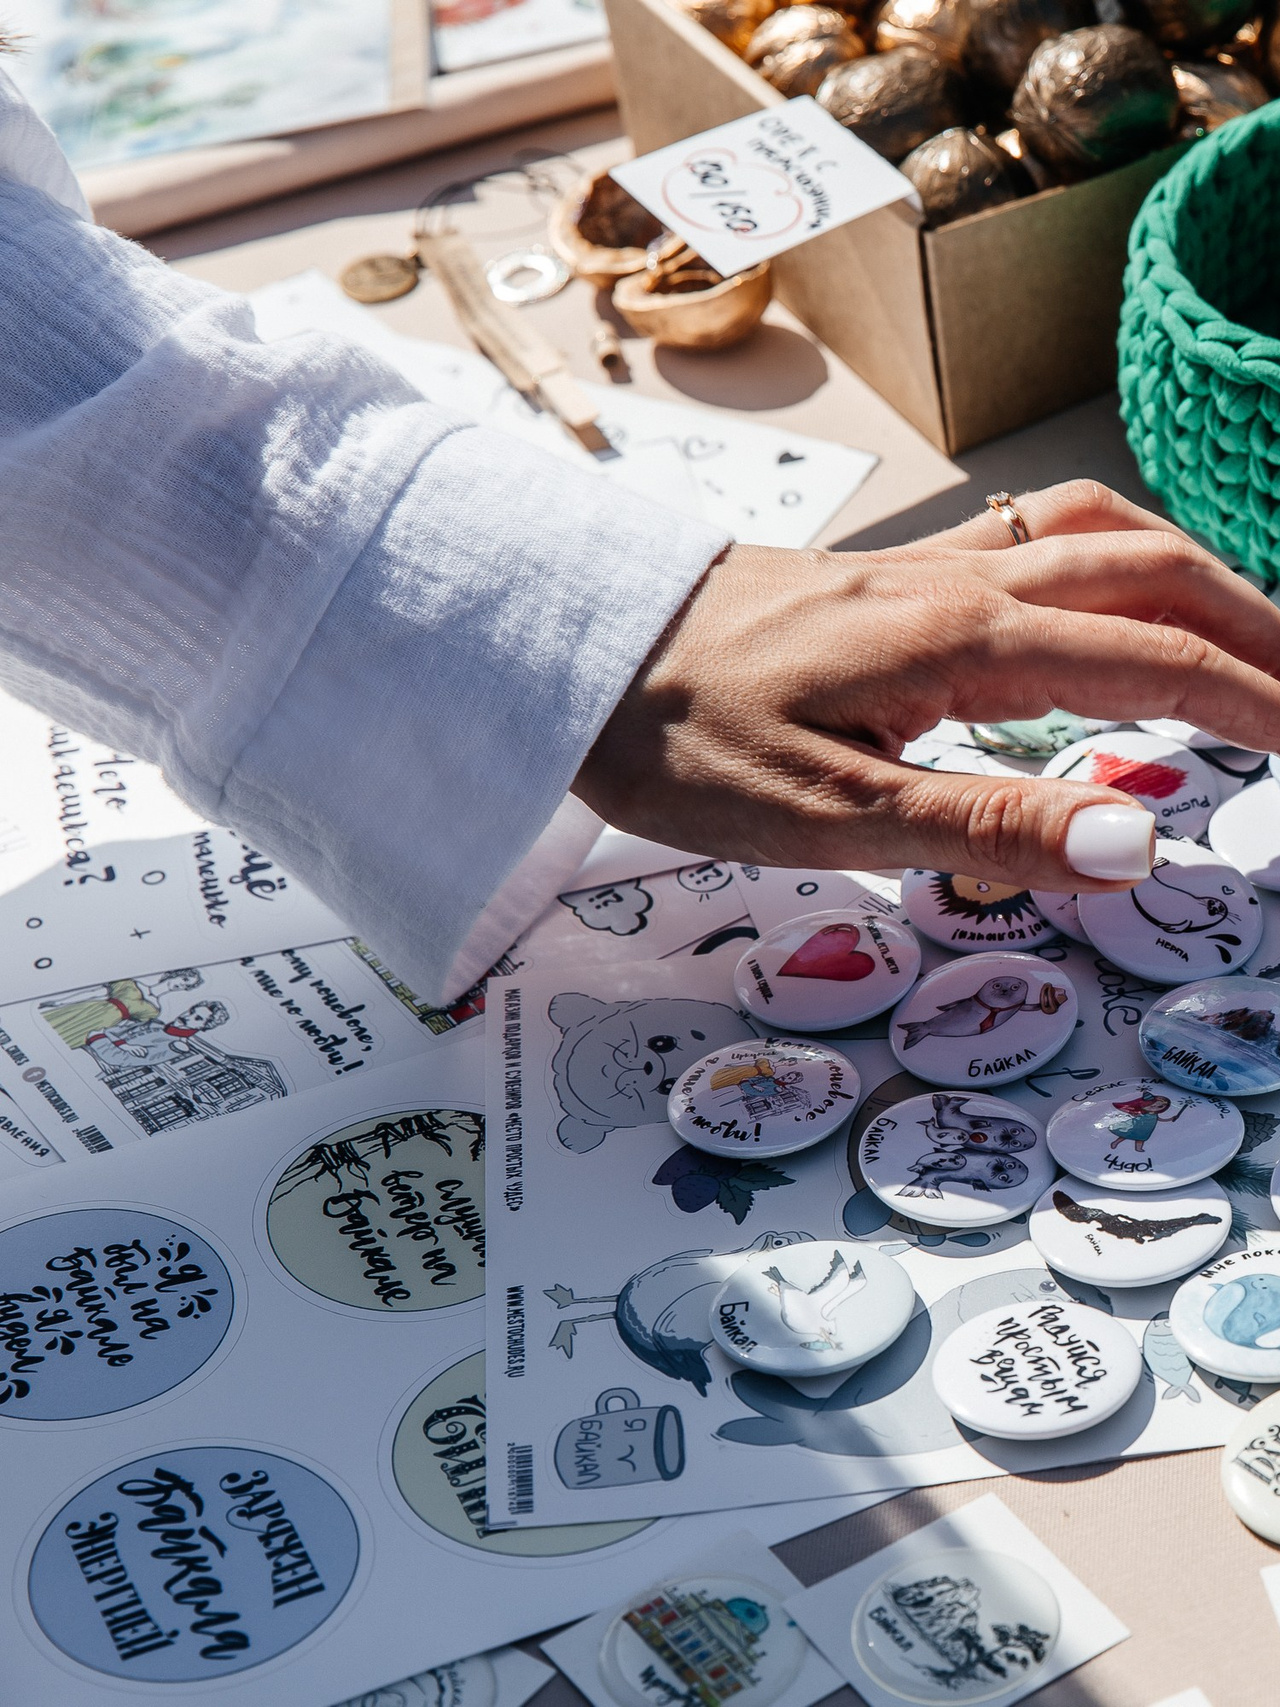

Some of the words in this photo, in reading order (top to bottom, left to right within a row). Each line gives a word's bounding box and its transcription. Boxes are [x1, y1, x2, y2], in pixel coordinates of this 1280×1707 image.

[967, 1048, 1038, 1078] БАЙКАЛ
[1162, 1046, 1219, 1079] БАЙКАЛ
[864, 1117, 898, 1164] БАЙКАЛ
[322, 1189, 412, 1308] Байкале
[380, 1169, 440, 1246] ветер
[421, 1247, 457, 1287] на
[46, 1247, 134, 1367] Байкале
[103, 1239, 151, 1295] был
[131, 1297, 171, 1340] на
[717, 1301, 759, 1359] Байкал
[996, 1315, 1089, 1416] простым
[574, 1418, 603, 1485] БАЙКАЛ
[64, 1510, 181, 1662] ЭНЕРГИЕЙ
[116, 1467, 251, 1661] Байкала
[217, 1469, 327, 1611] ЗАРЯЖЕН
